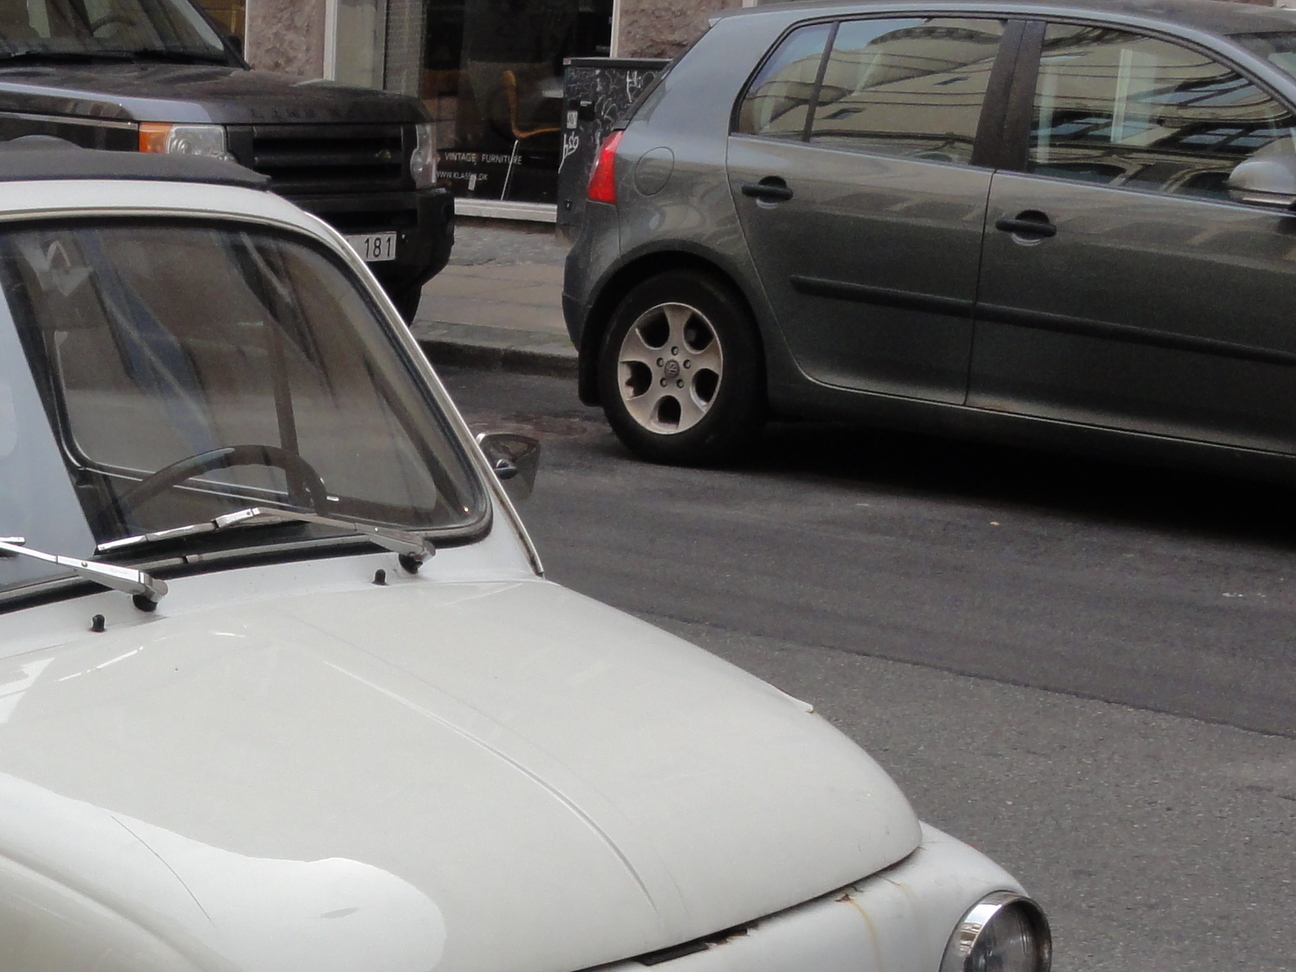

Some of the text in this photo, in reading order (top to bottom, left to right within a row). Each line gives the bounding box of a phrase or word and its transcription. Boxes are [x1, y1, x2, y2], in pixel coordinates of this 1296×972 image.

[445, 152, 522, 165] VINTAGE FURNITURE
[436, 170, 488, 181] WWW.KLASS.DK
[364, 237, 392, 258] 181
